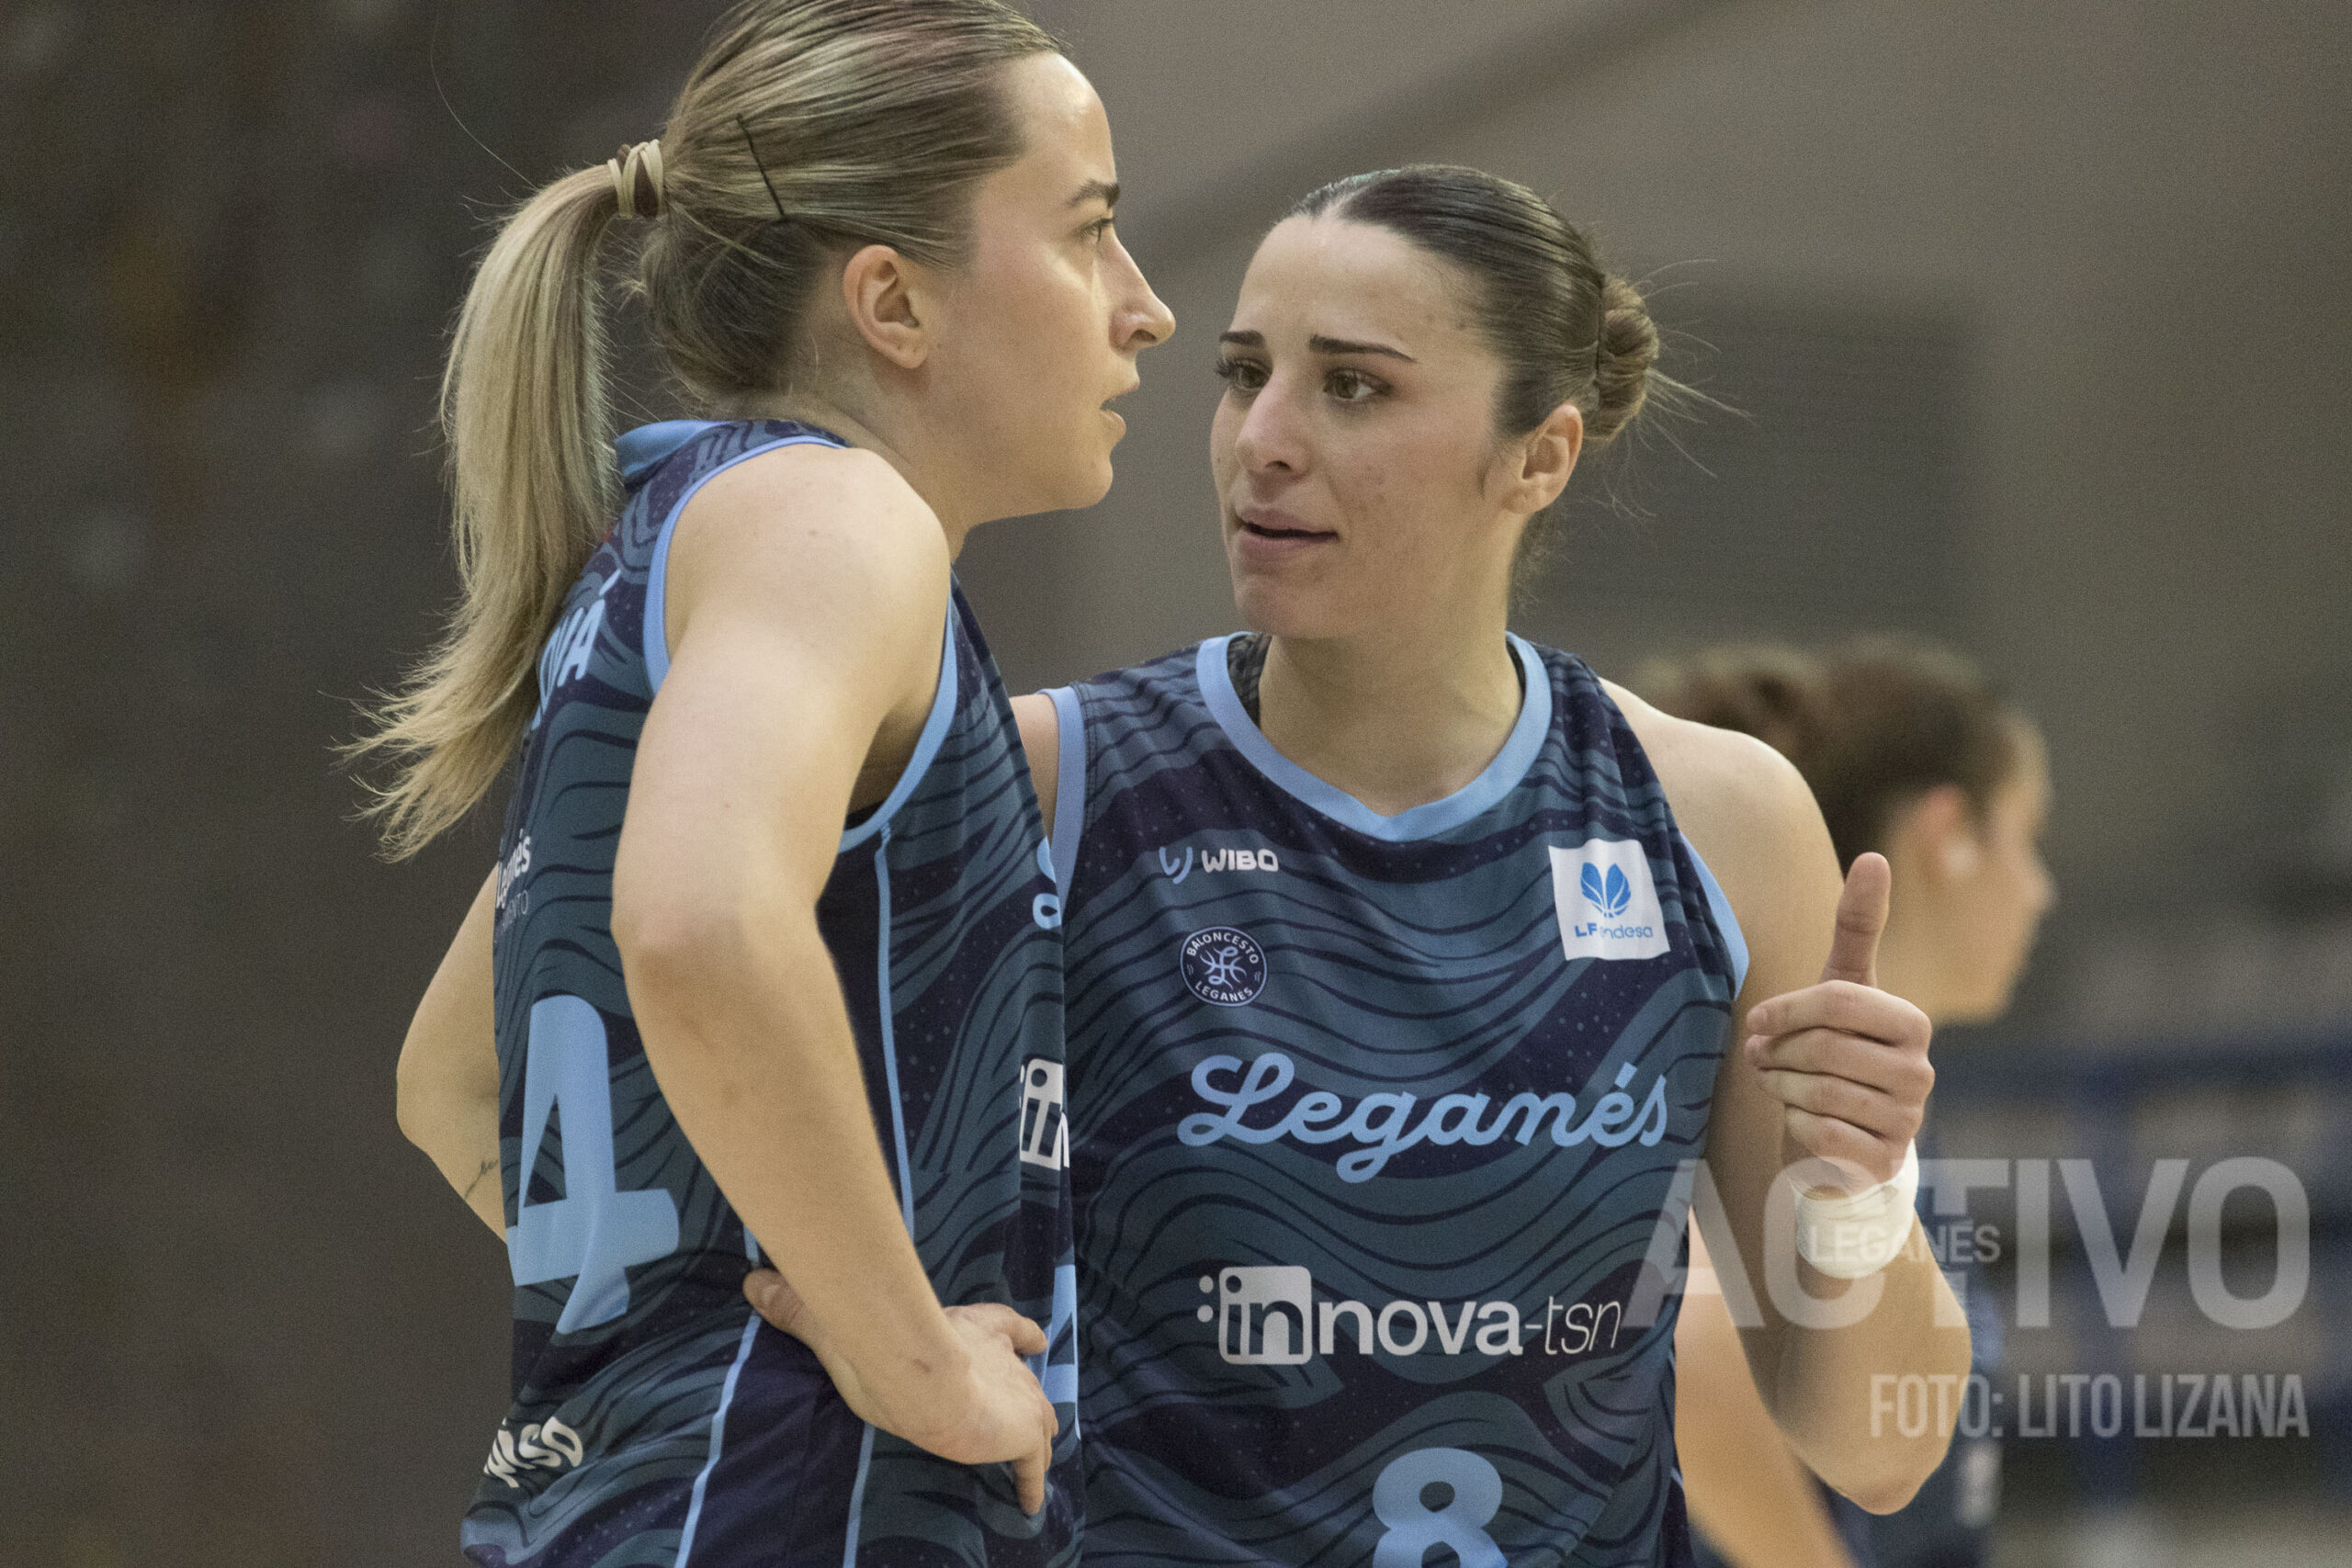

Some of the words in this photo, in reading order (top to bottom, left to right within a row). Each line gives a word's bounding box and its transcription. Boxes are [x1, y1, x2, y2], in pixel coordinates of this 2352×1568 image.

[1202, 849, 1278, 873] WIBO
[1187, 931, 1259, 964] BALONCESTO
[506, 995, 679, 1334] 4
[1178, 1052, 1668, 1182] Leganés
[1373, 1447, 1508, 1568] 8
